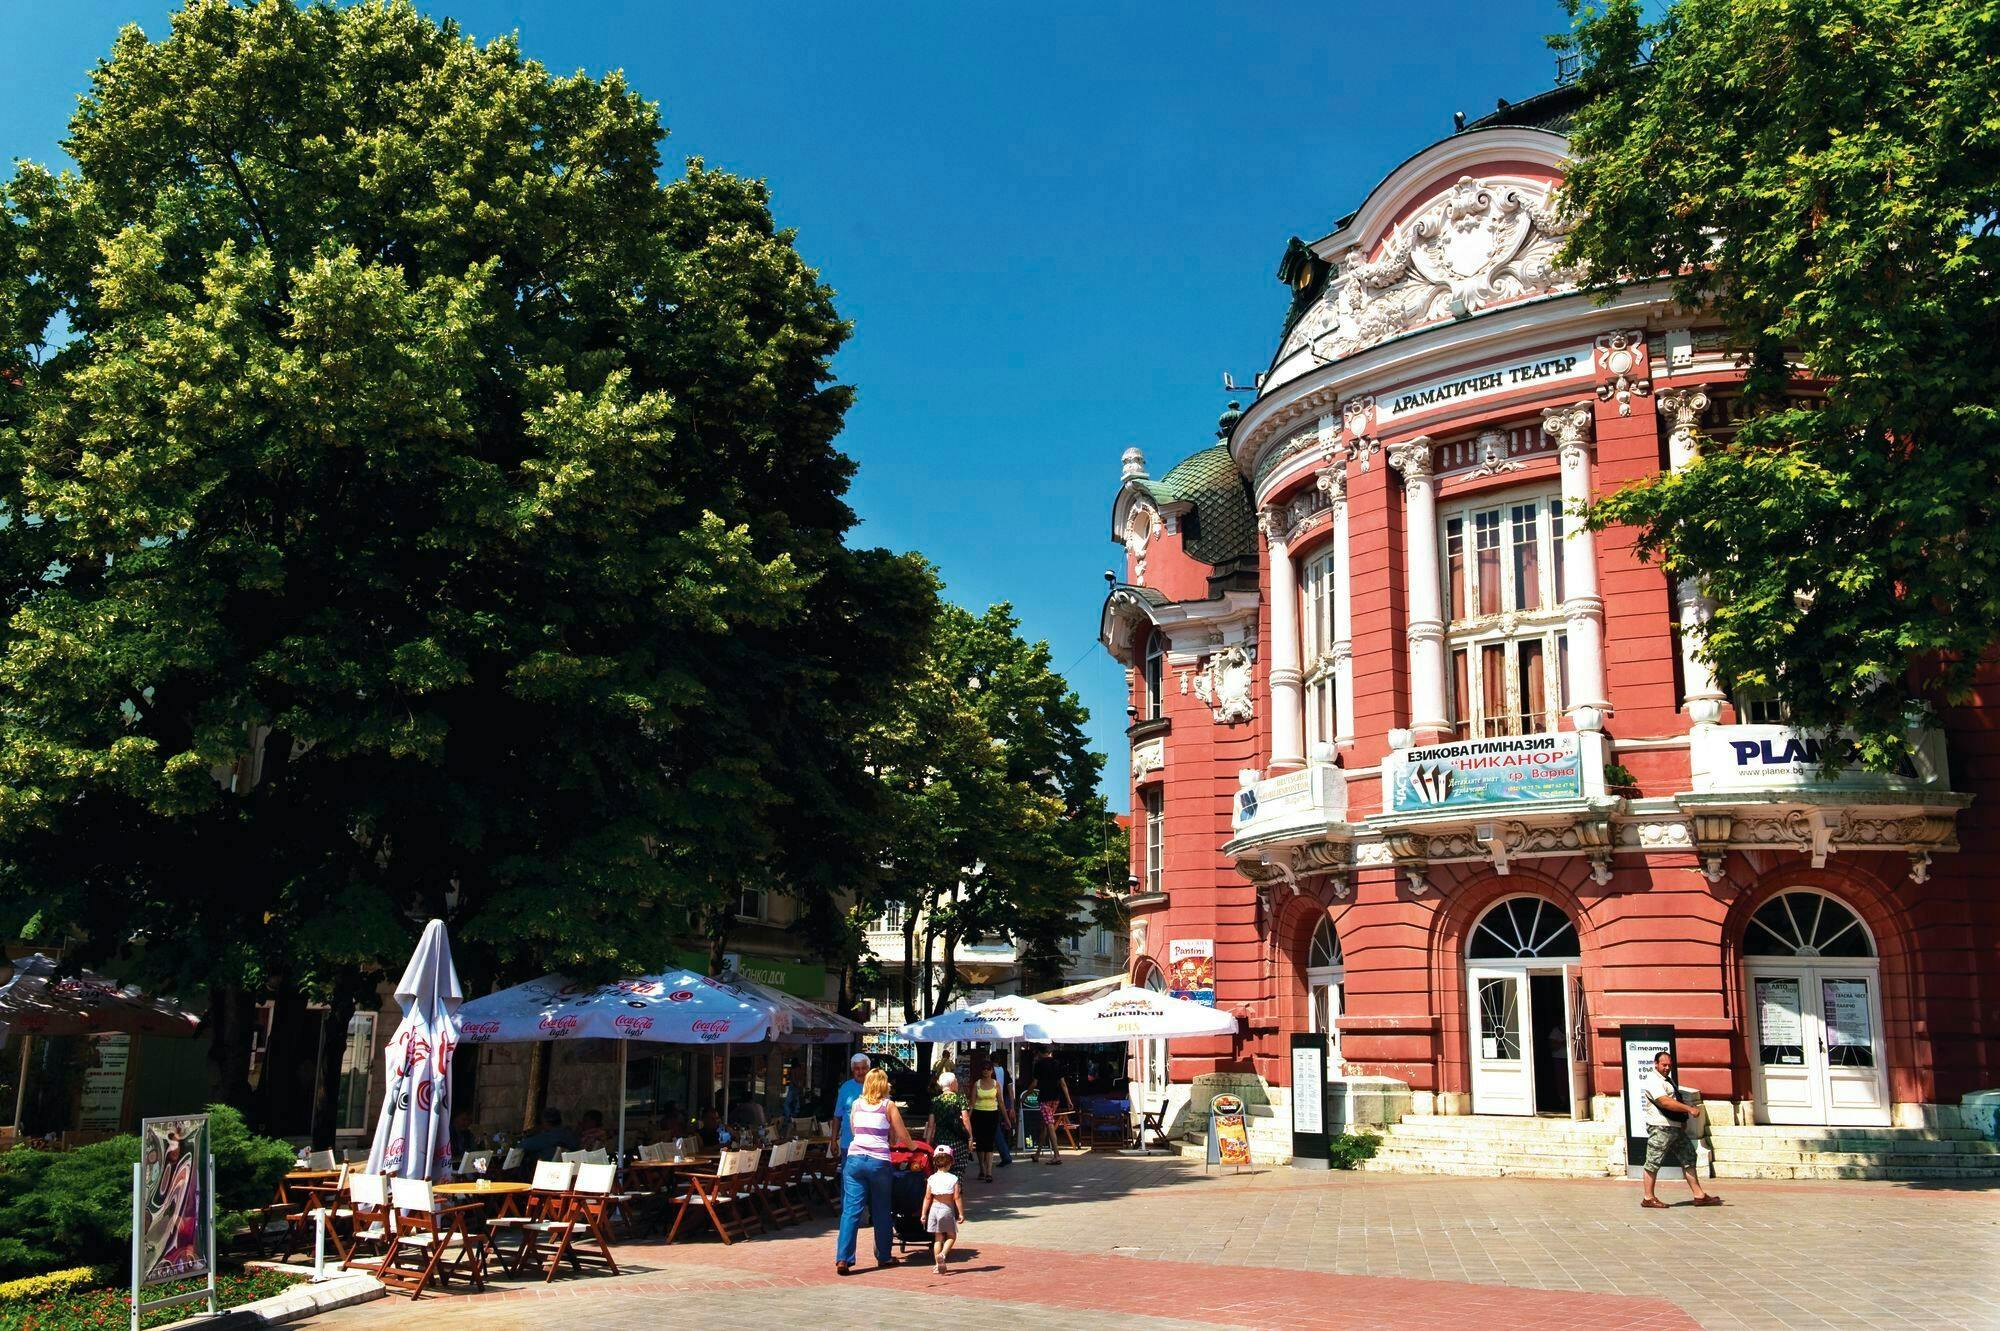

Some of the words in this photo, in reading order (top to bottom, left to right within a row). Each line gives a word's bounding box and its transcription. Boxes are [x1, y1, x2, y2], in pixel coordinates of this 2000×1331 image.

[1392, 372, 1503, 414] ДРАМАТИЧЕН
[1508, 356, 1577, 384] ТЕАТЪР
[1407, 745, 1469, 763] ЕЗИКОВА
[1470, 737, 1556, 756] ГИМНАЗИЯ
[1531, 767, 1576, 782] Варна
[1738, 767, 1804, 776] www.planex.bg
[550, 1028, 569, 1038] light
[624, 1026, 644, 1037] light
[700, 1031, 720, 1041] light
[471, 1033, 490, 1041] light
